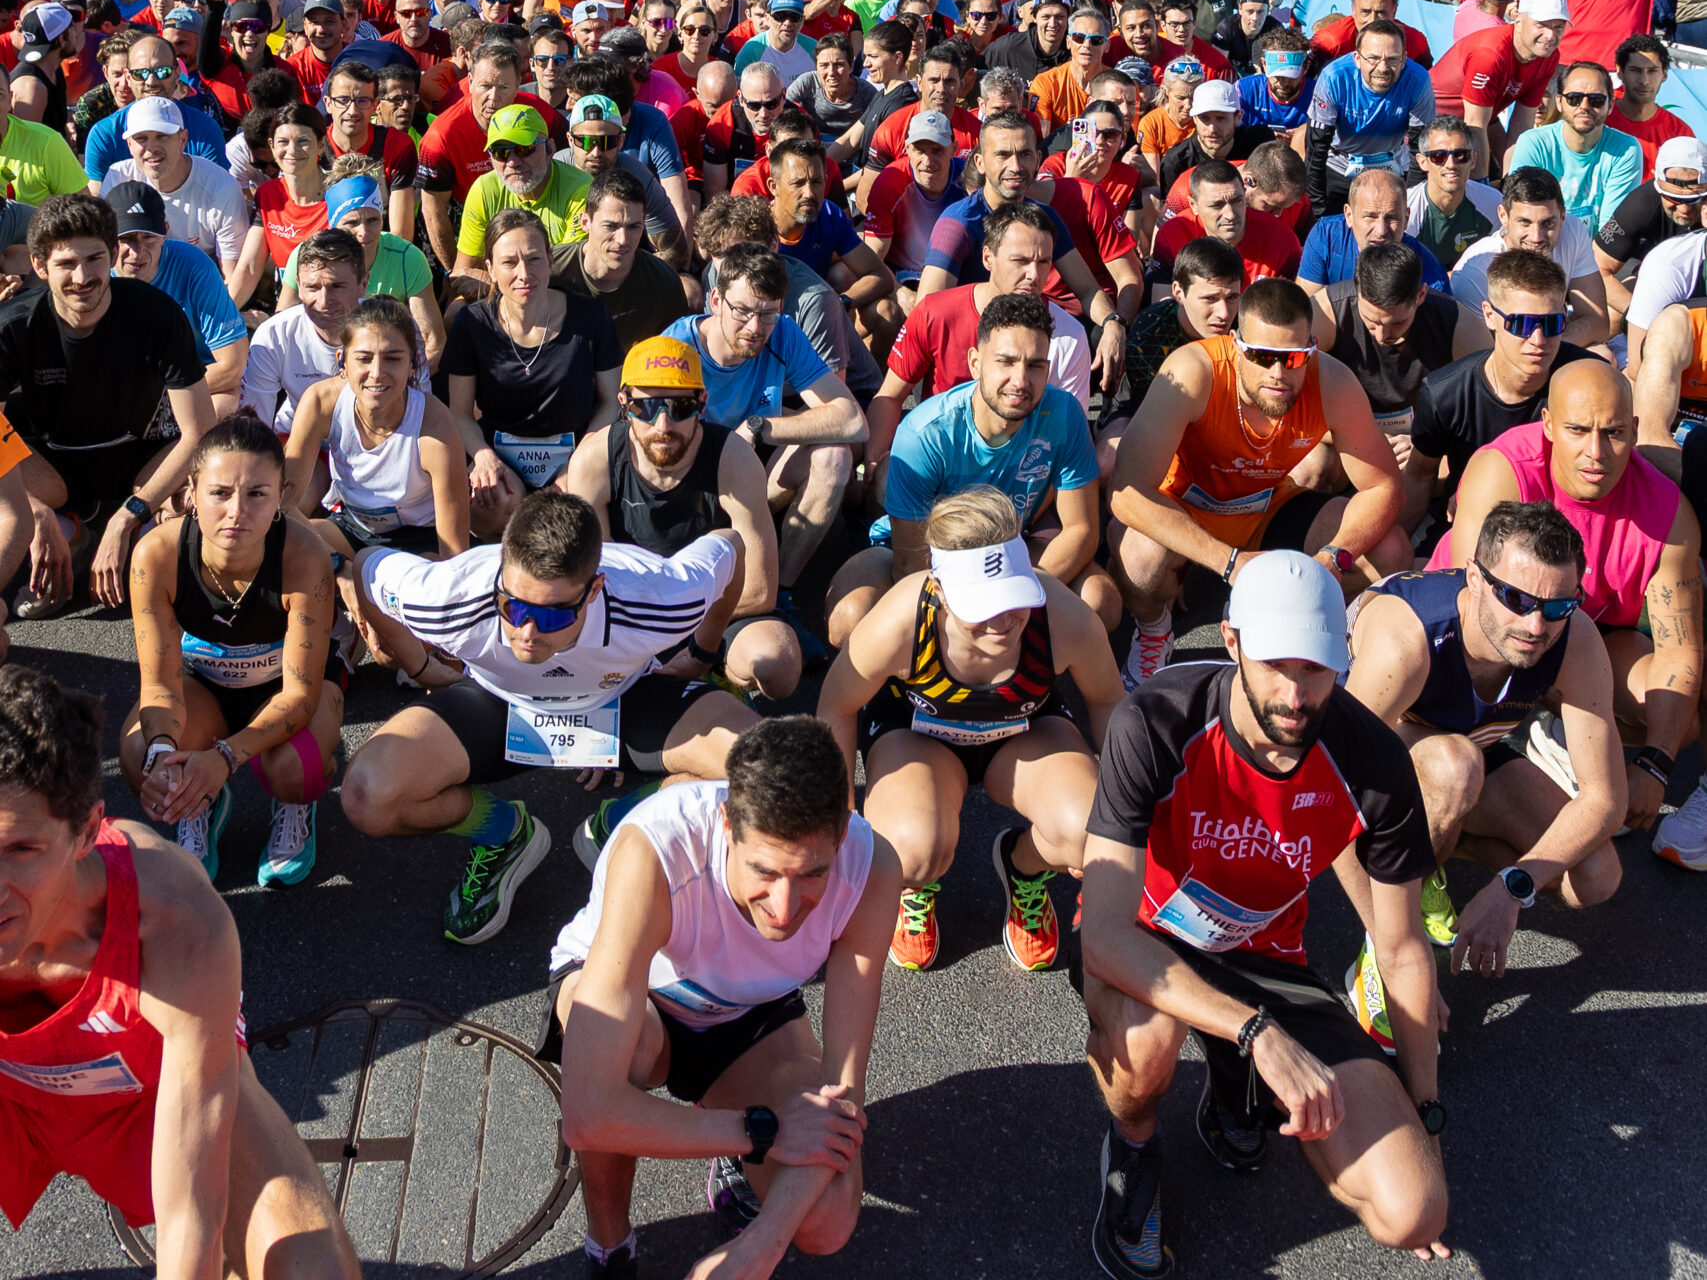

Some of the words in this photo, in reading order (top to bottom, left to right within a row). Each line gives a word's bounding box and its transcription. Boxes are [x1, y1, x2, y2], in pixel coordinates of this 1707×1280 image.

[645, 355, 690, 374] HOKA
[517, 451, 551, 461] ANNA
[522, 464, 546, 474] 6008
[192, 655, 278, 670] AMANDINE
[223, 670, 248, 679] 622
[534, 714, 593, 729] DANIEL
[549, 734, 576, 747] 795
[928, 729, 1012, 739] NATHALIE
[1190, 811, 1312, 856] Triathlon
[1191, 838, 1218, 850] CLUB
[1363, 964, 1383, 1022] HOKA
